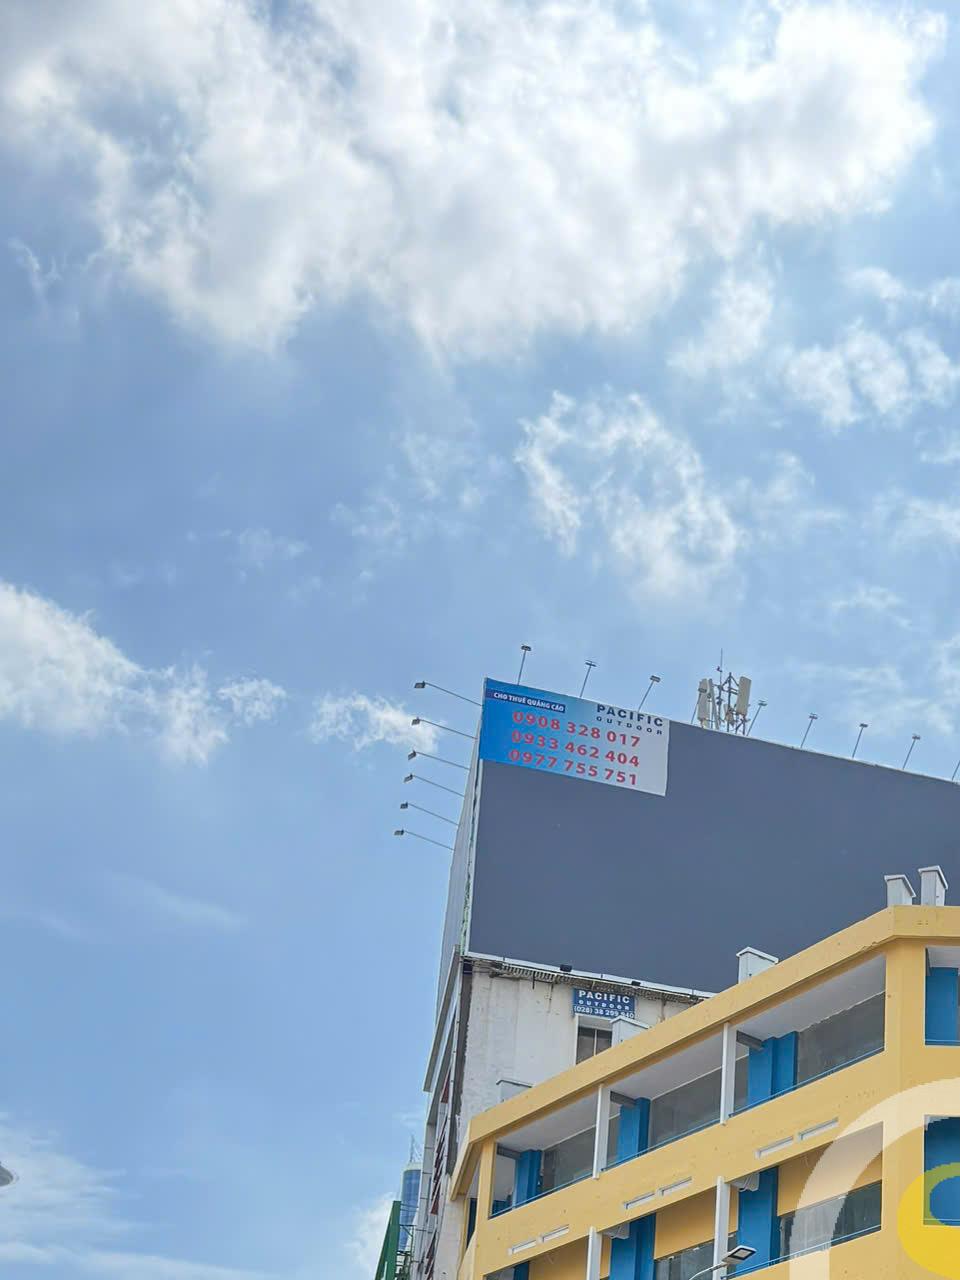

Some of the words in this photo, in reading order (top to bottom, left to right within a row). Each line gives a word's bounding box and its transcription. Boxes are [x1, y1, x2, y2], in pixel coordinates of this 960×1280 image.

[494, 692, 508, 700] CHO
[597, 704, 663, 727] PACIFIC
[512, 711, 561, 731] 0908
[566, 721, 601, 740] 328
[606, 730, 640, 747] 017
[596, 716, 663, 736] OUTDOOR
[511, 730, 559, 749] 0933
[565, 741, 600, 759] 462
[605, 750, 640, 767] 404
[509, 749, 557, 768] 0977
[564, 760, 598, 777] 755
[604, 768, 638, 785] 751
[578, 990, 630, 1004] PACIFIC
[578, 999, 630, 1011] OUTDOOR
[573, 1005, 593, 1014] (028)
